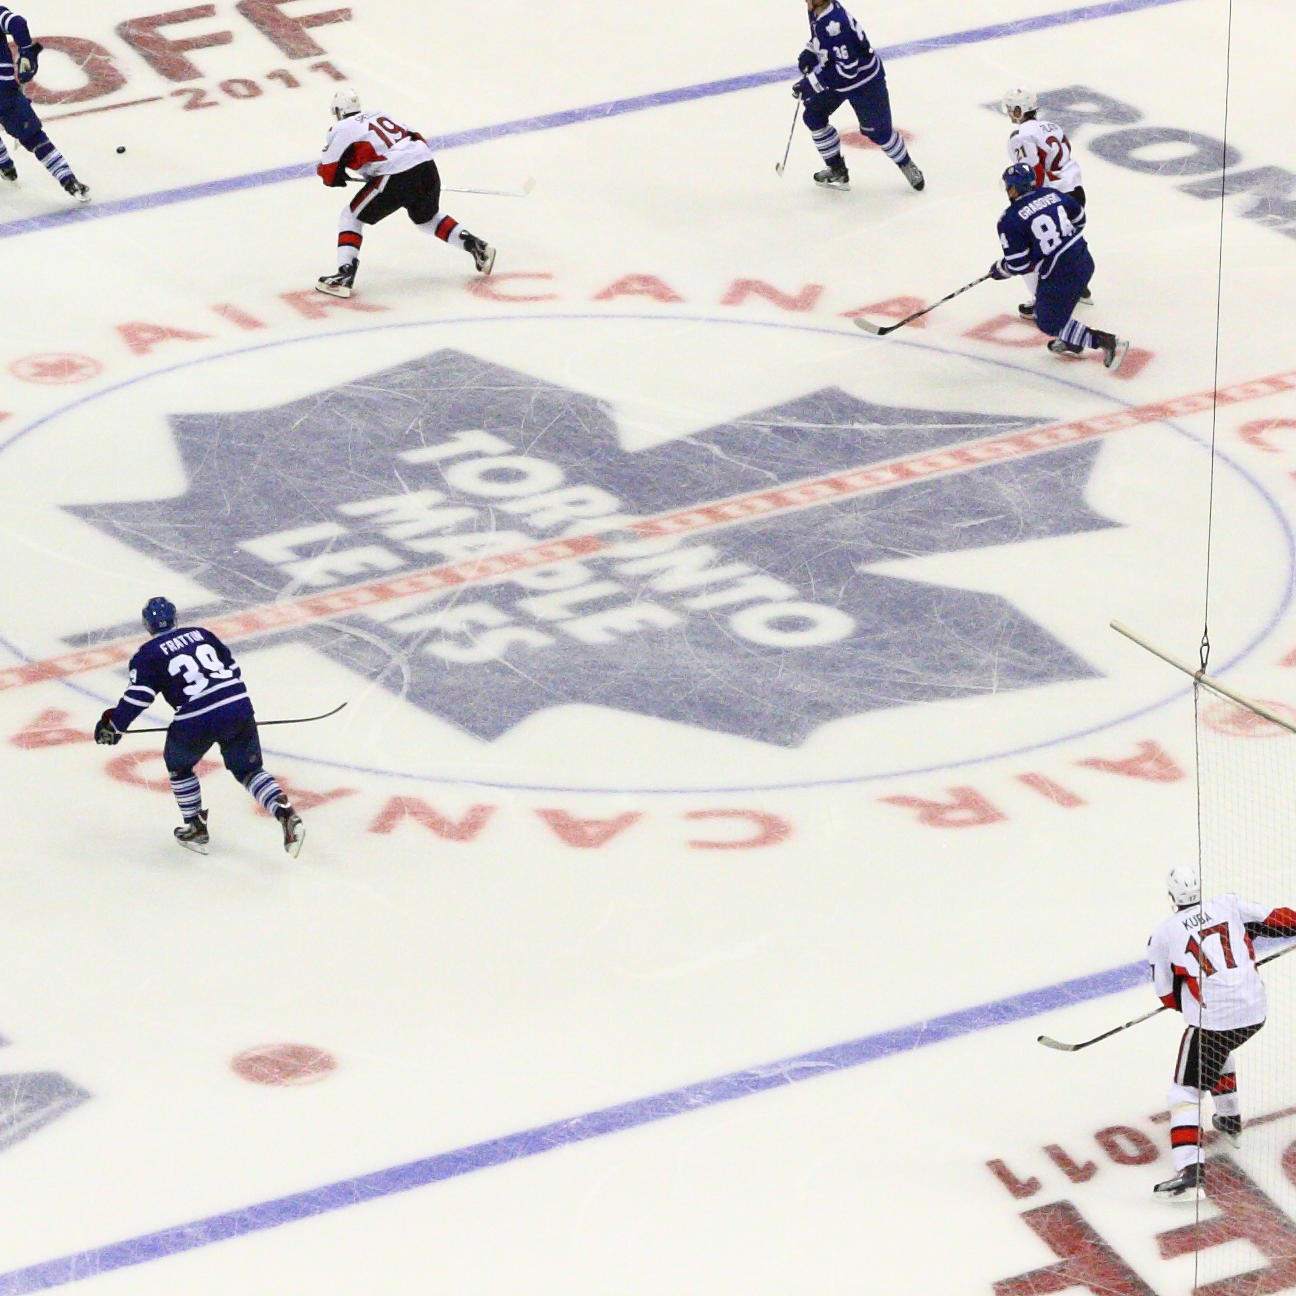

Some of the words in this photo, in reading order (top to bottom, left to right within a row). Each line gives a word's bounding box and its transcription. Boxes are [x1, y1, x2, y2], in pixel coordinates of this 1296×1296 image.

[170, 60, 350, 111] 2011
[368, 116, 409, 149] 19
[114, 287, 390, 357] AIR
[167, 643, 233, 697] 39
[878, 740, 1187, 830] AIR
[1181, 911, 1213, 931] KUBA
[1184, 921, 1238, 978] 17
